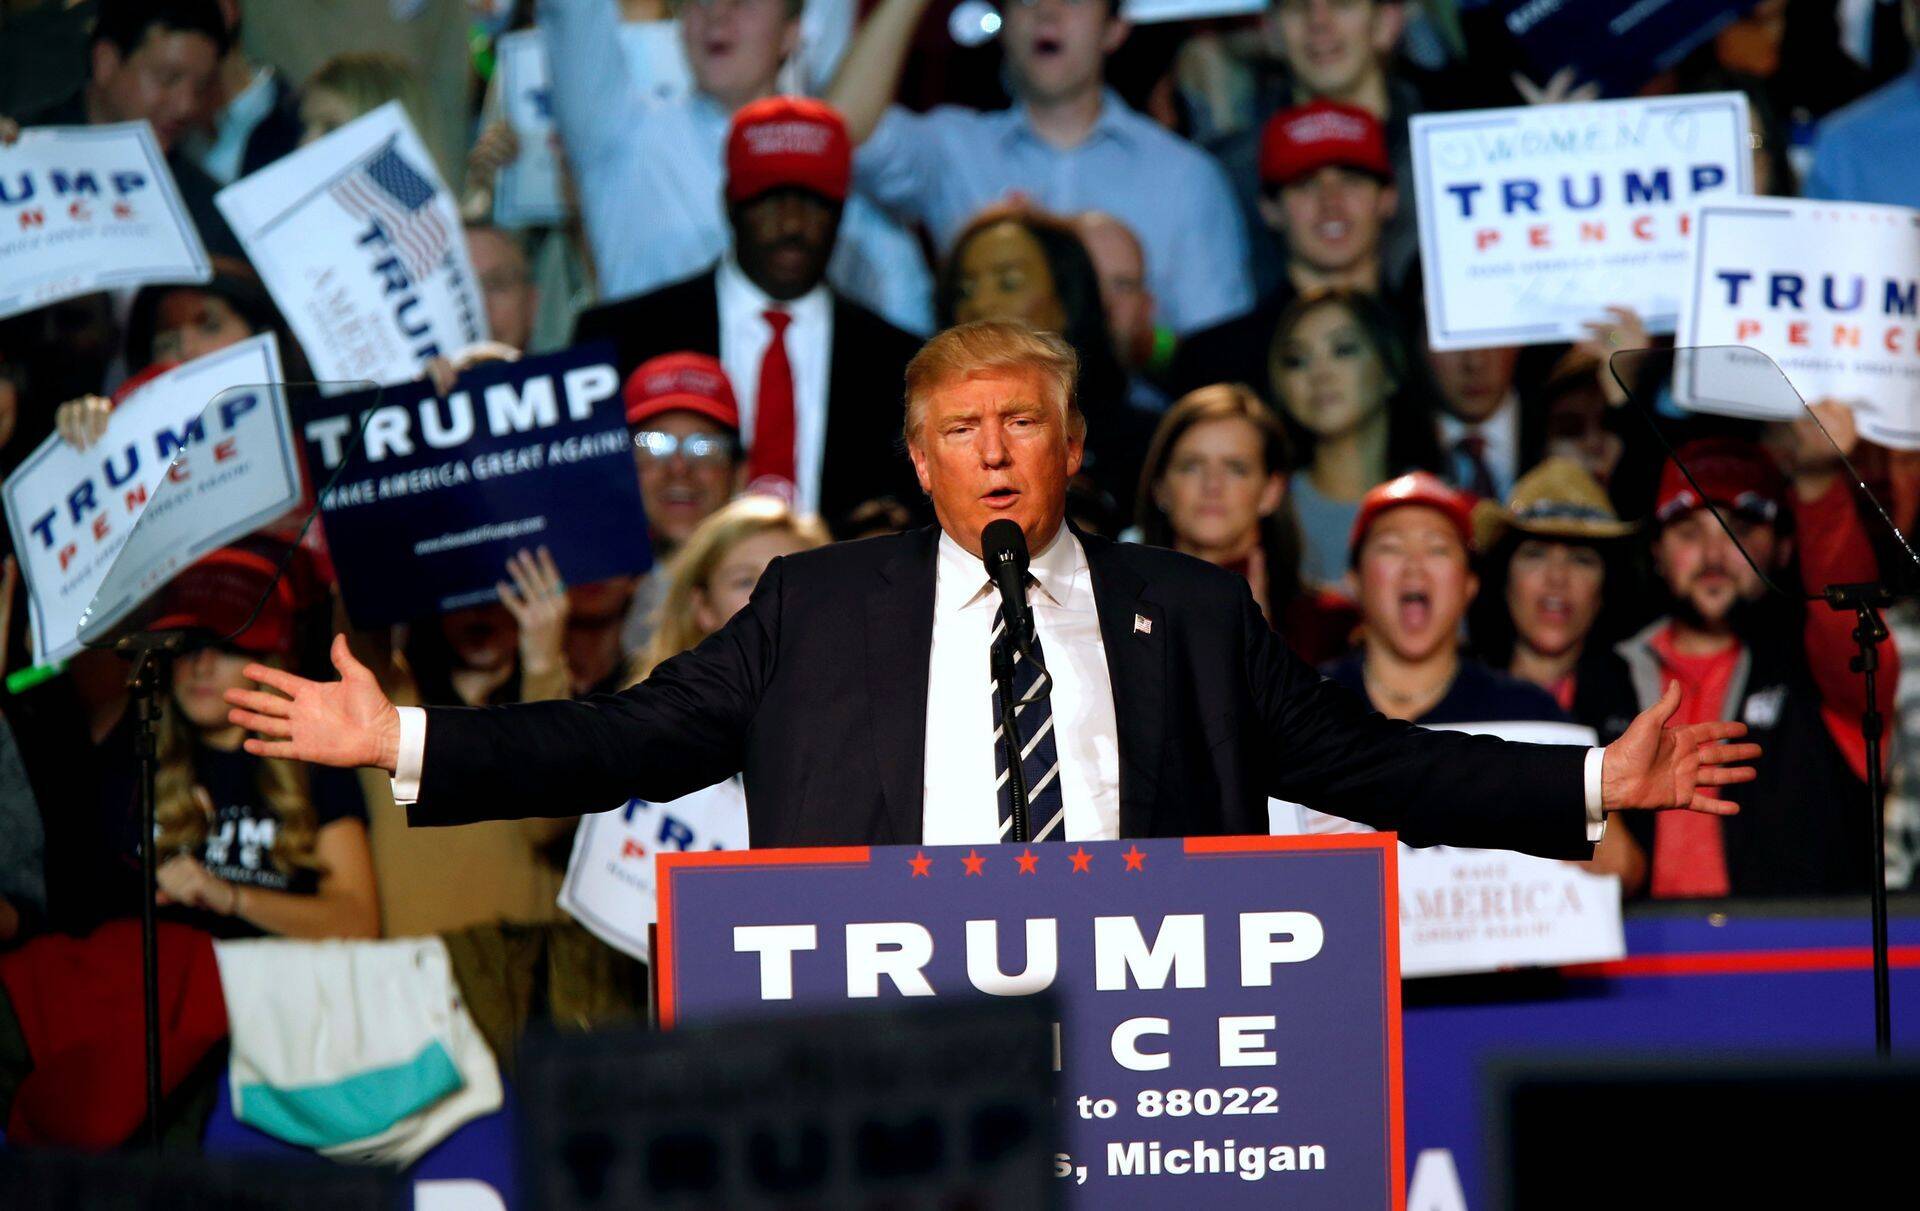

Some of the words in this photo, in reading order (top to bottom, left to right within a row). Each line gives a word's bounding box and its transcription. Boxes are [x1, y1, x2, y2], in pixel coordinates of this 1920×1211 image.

[1445, 164, 1727, 218] TRUMP
[1736, 319, 1920, 354] PENC
[304, 362, 621, 471] TRUMP
[30, 392, 259, 549] TRUMP
[378, 459, 471, 500] AMERICA
[471, 443, 545, 481] GREAT
[57, 436, 238, 572] PENCE
[733, 911, 1325, 1000] TRUMP
[1077, 1095, 1118, 1119] to
[1136, 1086, 1279, 1118] 88022
[1107, 1141, 1326, 1183] Michigan
